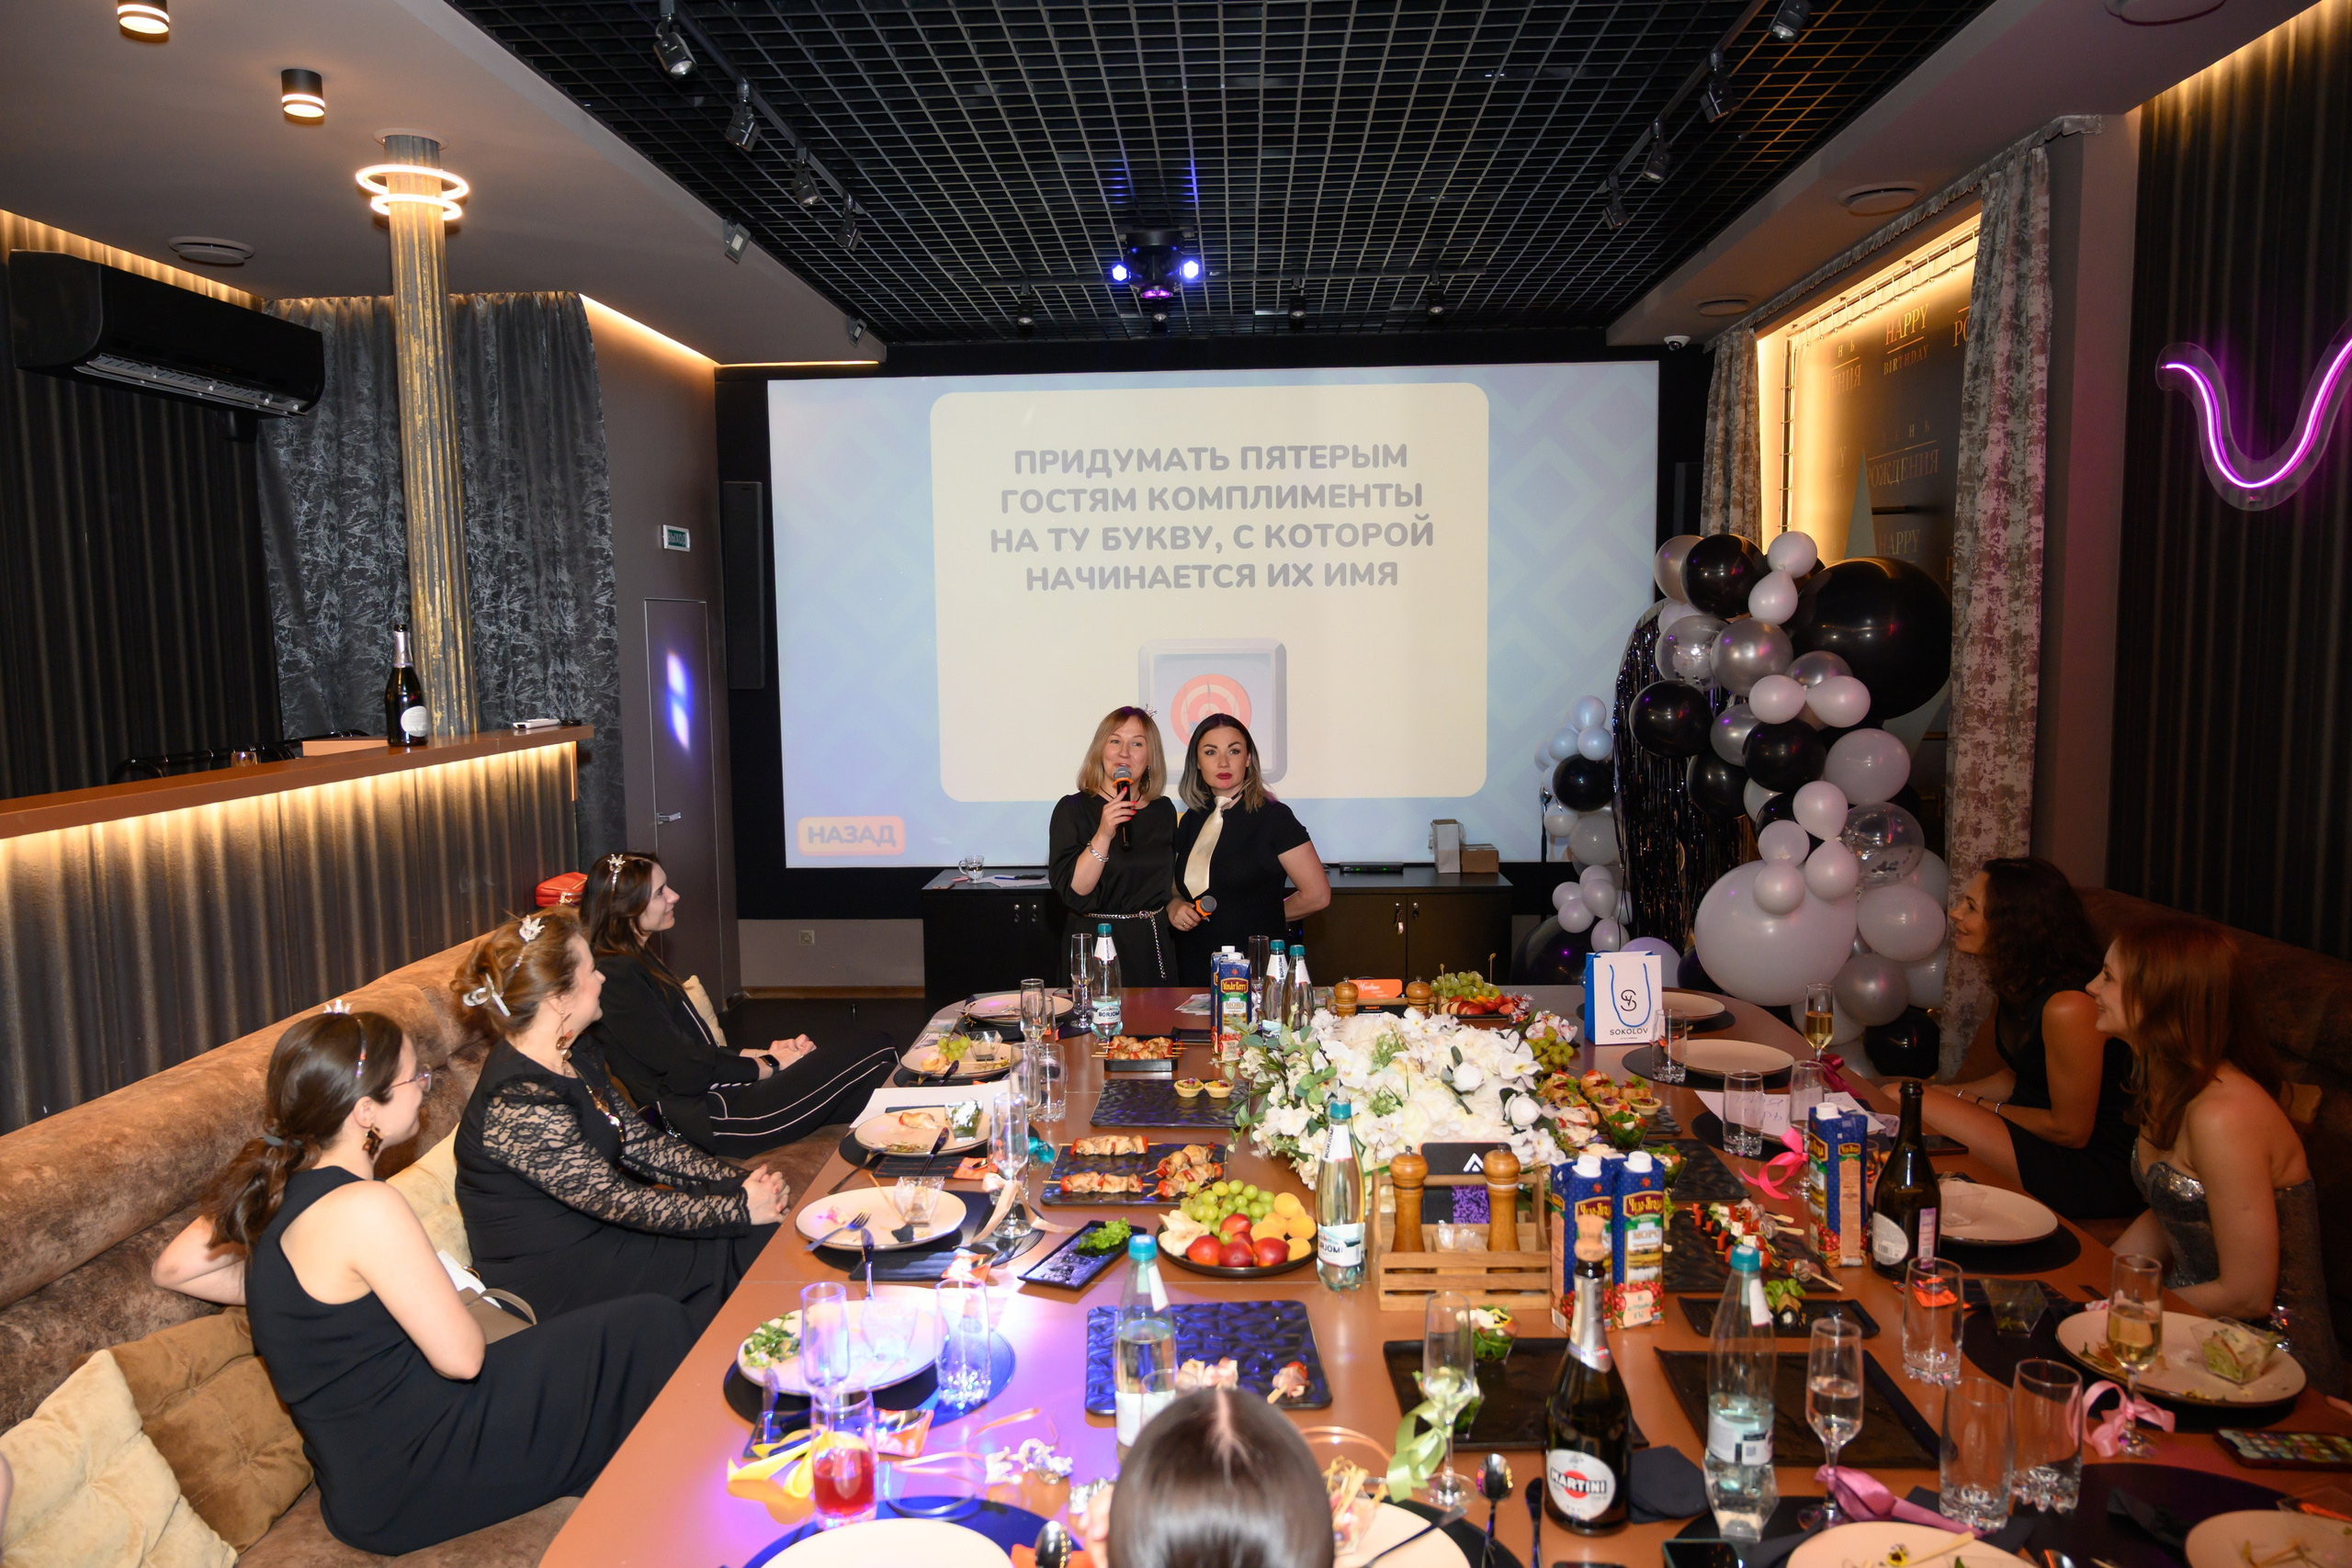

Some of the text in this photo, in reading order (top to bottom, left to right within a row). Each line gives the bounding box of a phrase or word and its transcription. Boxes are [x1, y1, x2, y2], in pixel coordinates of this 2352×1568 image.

[1884, 303, 1929, 346] HAPPY
[1883, 344, 1929, 376] BIRTHDAY
[1014, 443, 1408, 479] ПРИДУМАТЬ ПЯТЕРЫМ
[1001, 482, 1423, 514] ГОСТЯМ КОМПЛИМЕНТЫ
[990, 513, 1434, 555] НА ТУ БУКВУ, С КОТОРОЙ
[1026, 561, 1398, 592] НАЧИНАЕТСЯ ИХ ИМЯ
[808, 824, 897, 848] НАЗАД
[1609, 1028, 1649, 1036] SOKOLOV
[1325, 1126, 1334, 1159] BORJOMI
[1550, 1467, 1608, 1495] MARTINI
